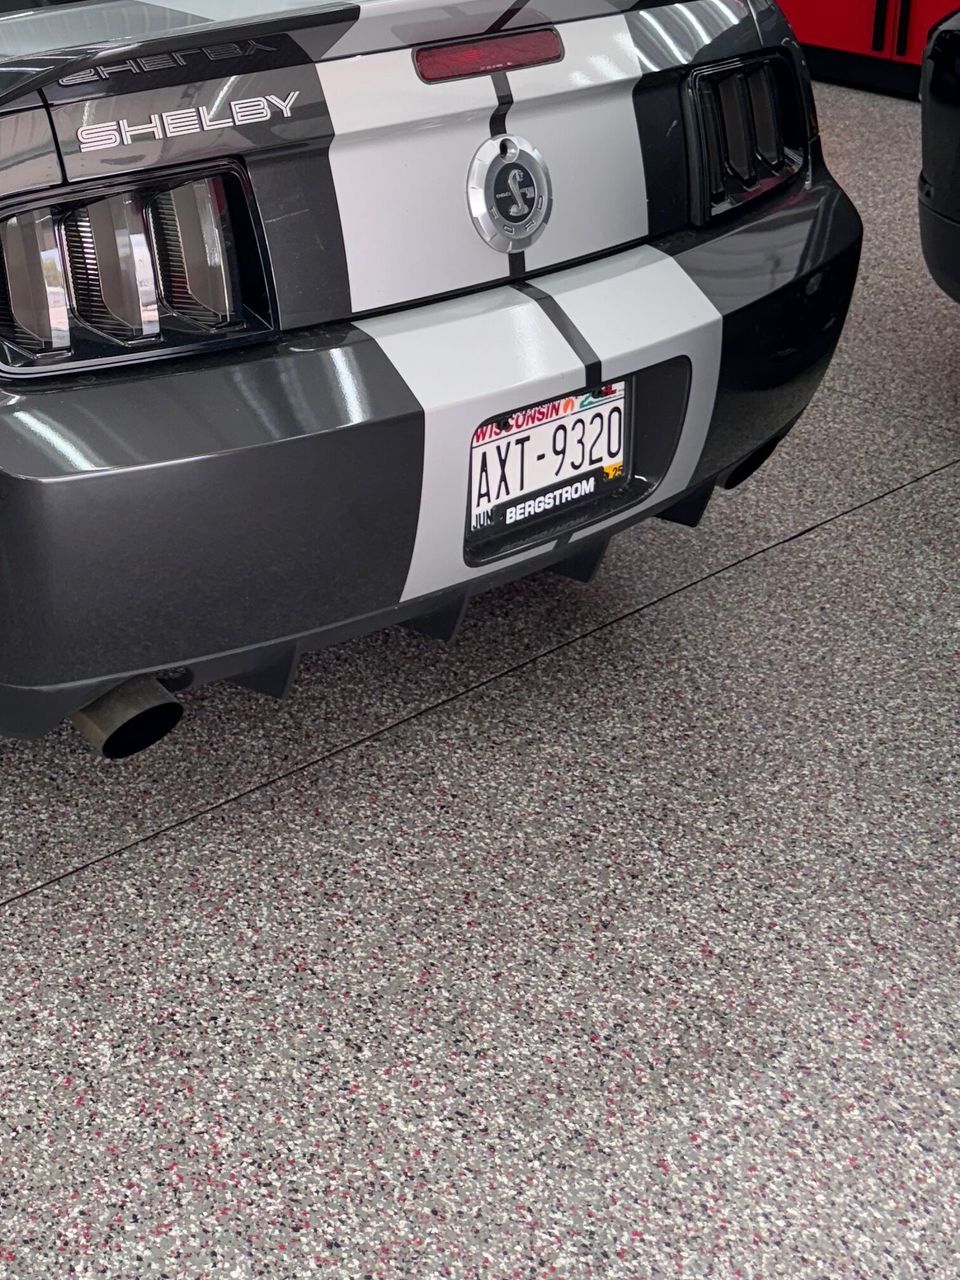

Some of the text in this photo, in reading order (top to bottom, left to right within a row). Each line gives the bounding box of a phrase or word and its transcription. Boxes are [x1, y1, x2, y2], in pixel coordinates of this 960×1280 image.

[76, 90, 300, 153] SHELBY
[476, 405, 623, 509] AXT-9320
[505, 476, 596, 525] BERGSTROM
